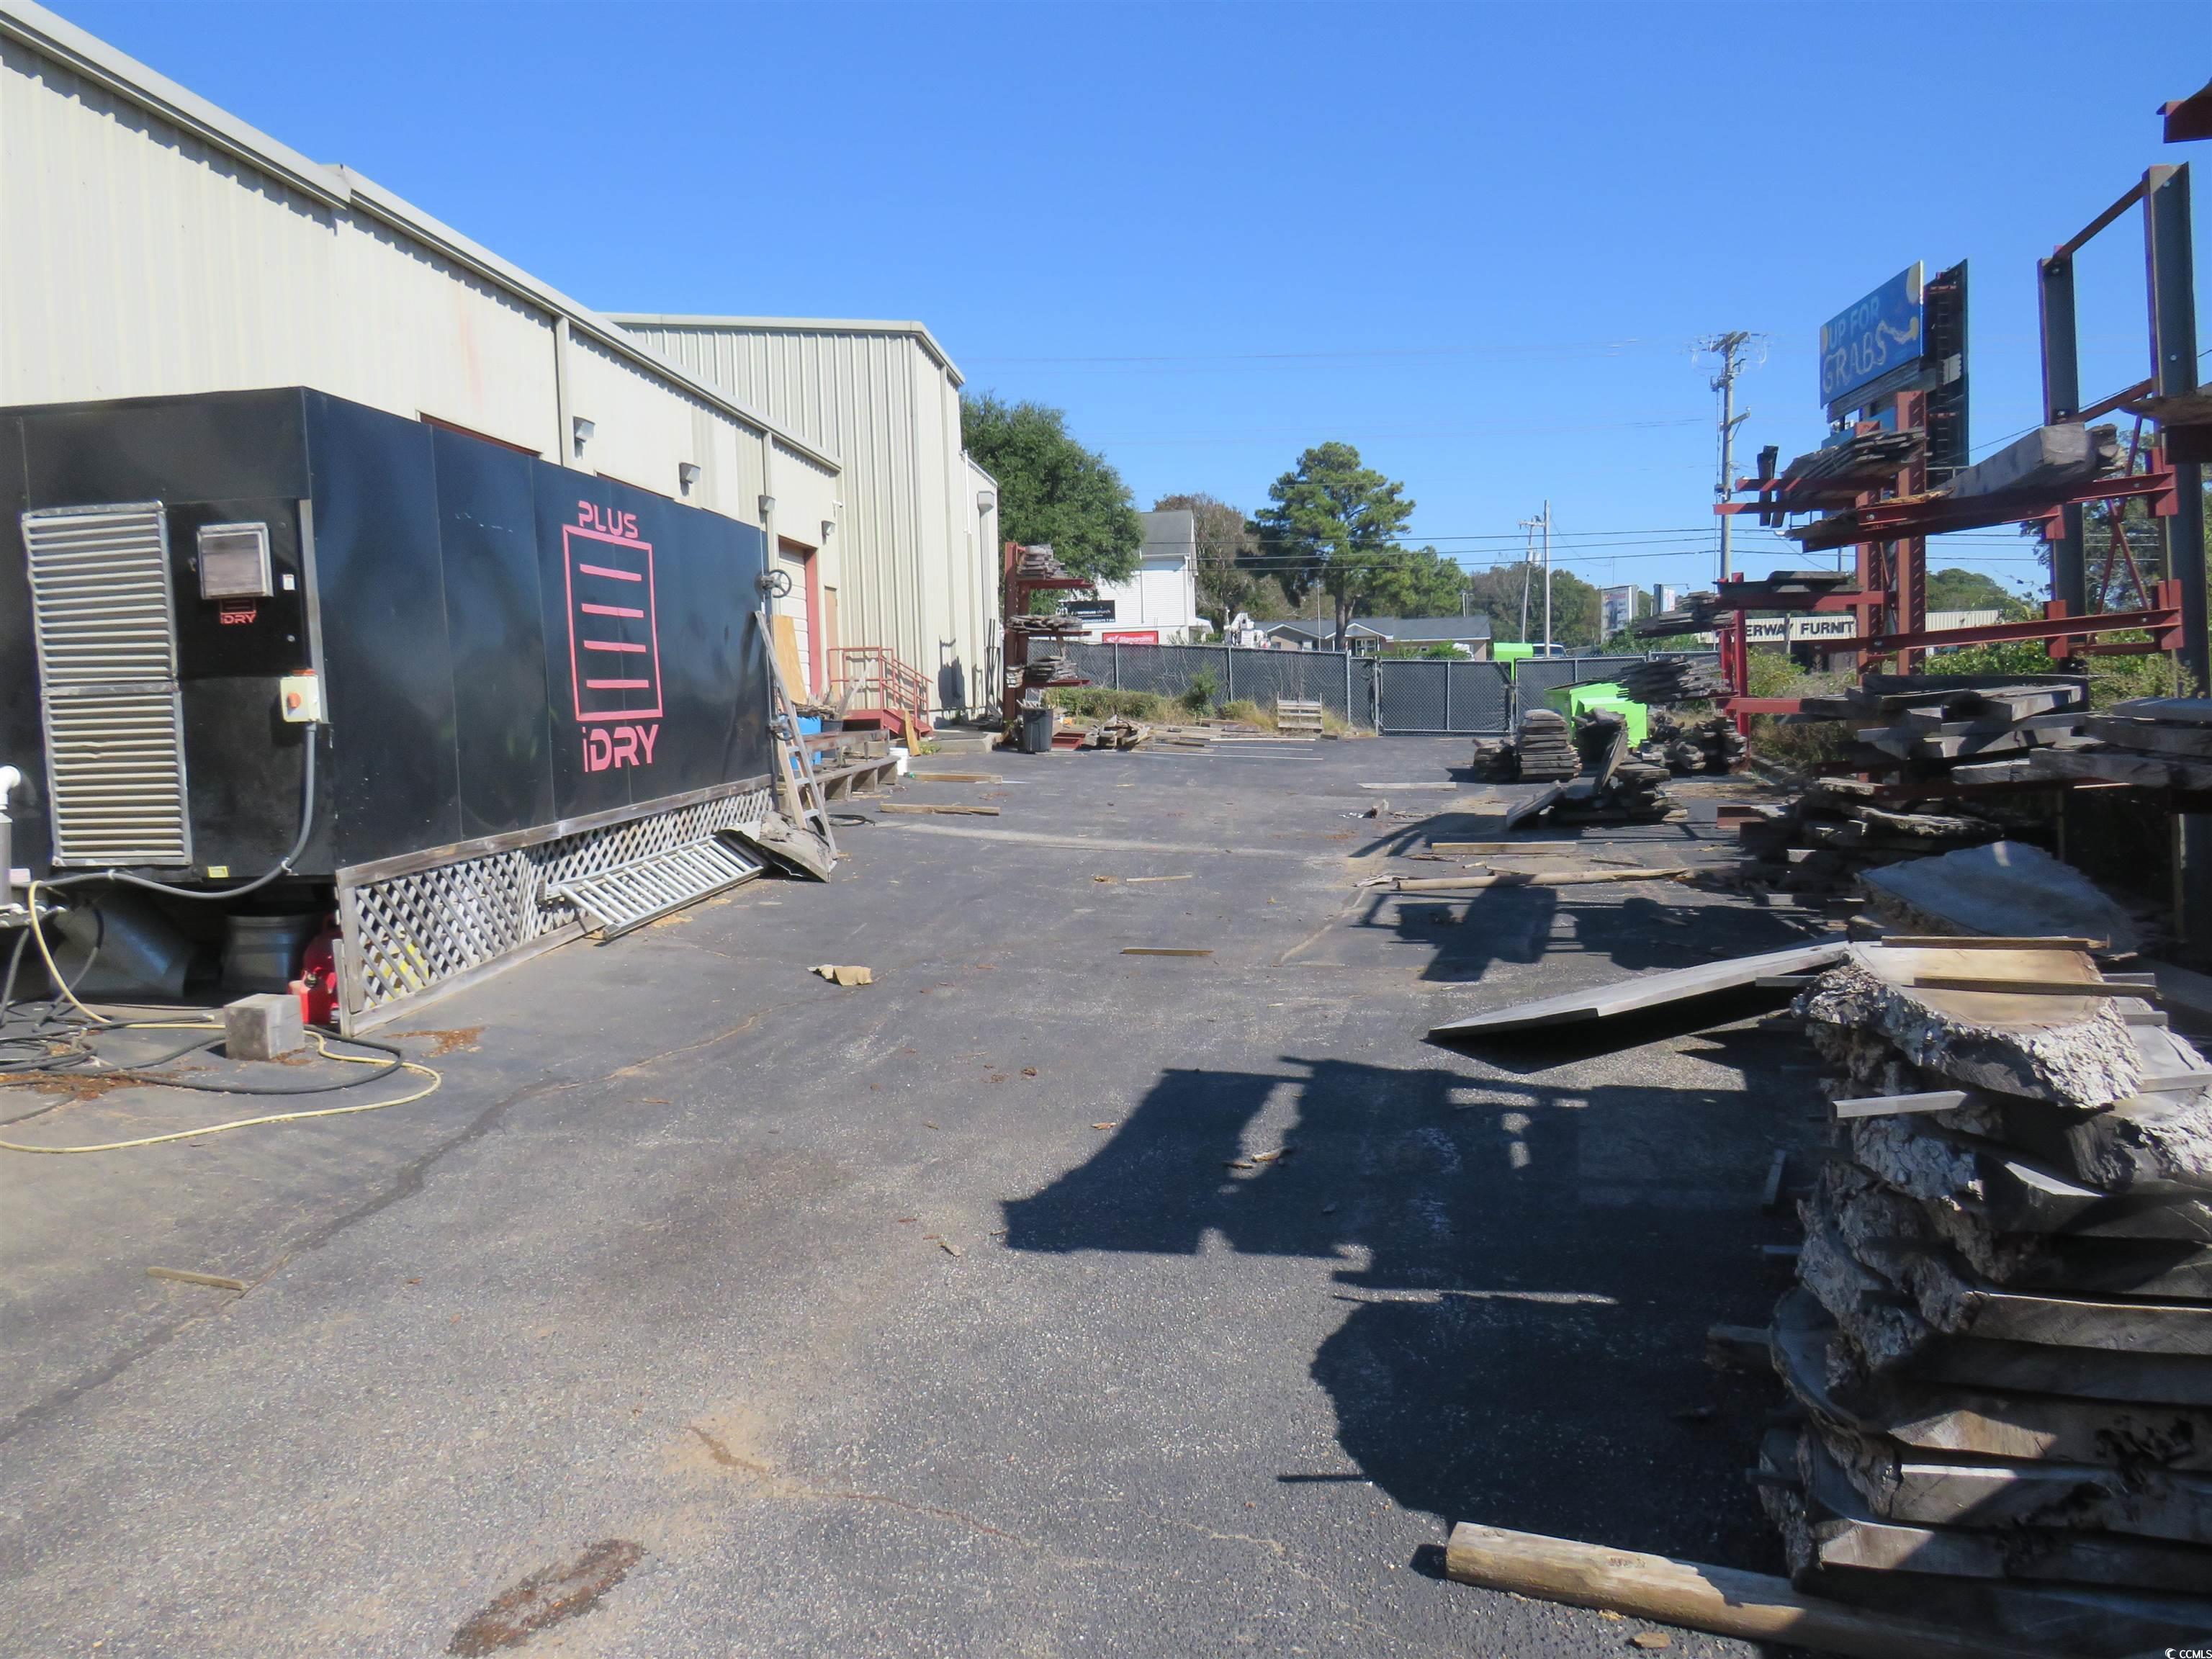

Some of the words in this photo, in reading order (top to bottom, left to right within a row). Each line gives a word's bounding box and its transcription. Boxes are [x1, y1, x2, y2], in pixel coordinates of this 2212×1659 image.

[1829, 318, 1845, 349] UP
[1851, 296, 1879, 338] FOR
[1823, 320, 1887, 393] GRABS
[578, 500, 639, 539] PLUS
[1801, 621, 1855, 635] FURNIT
[583, 724, 659, 773] iDRY
